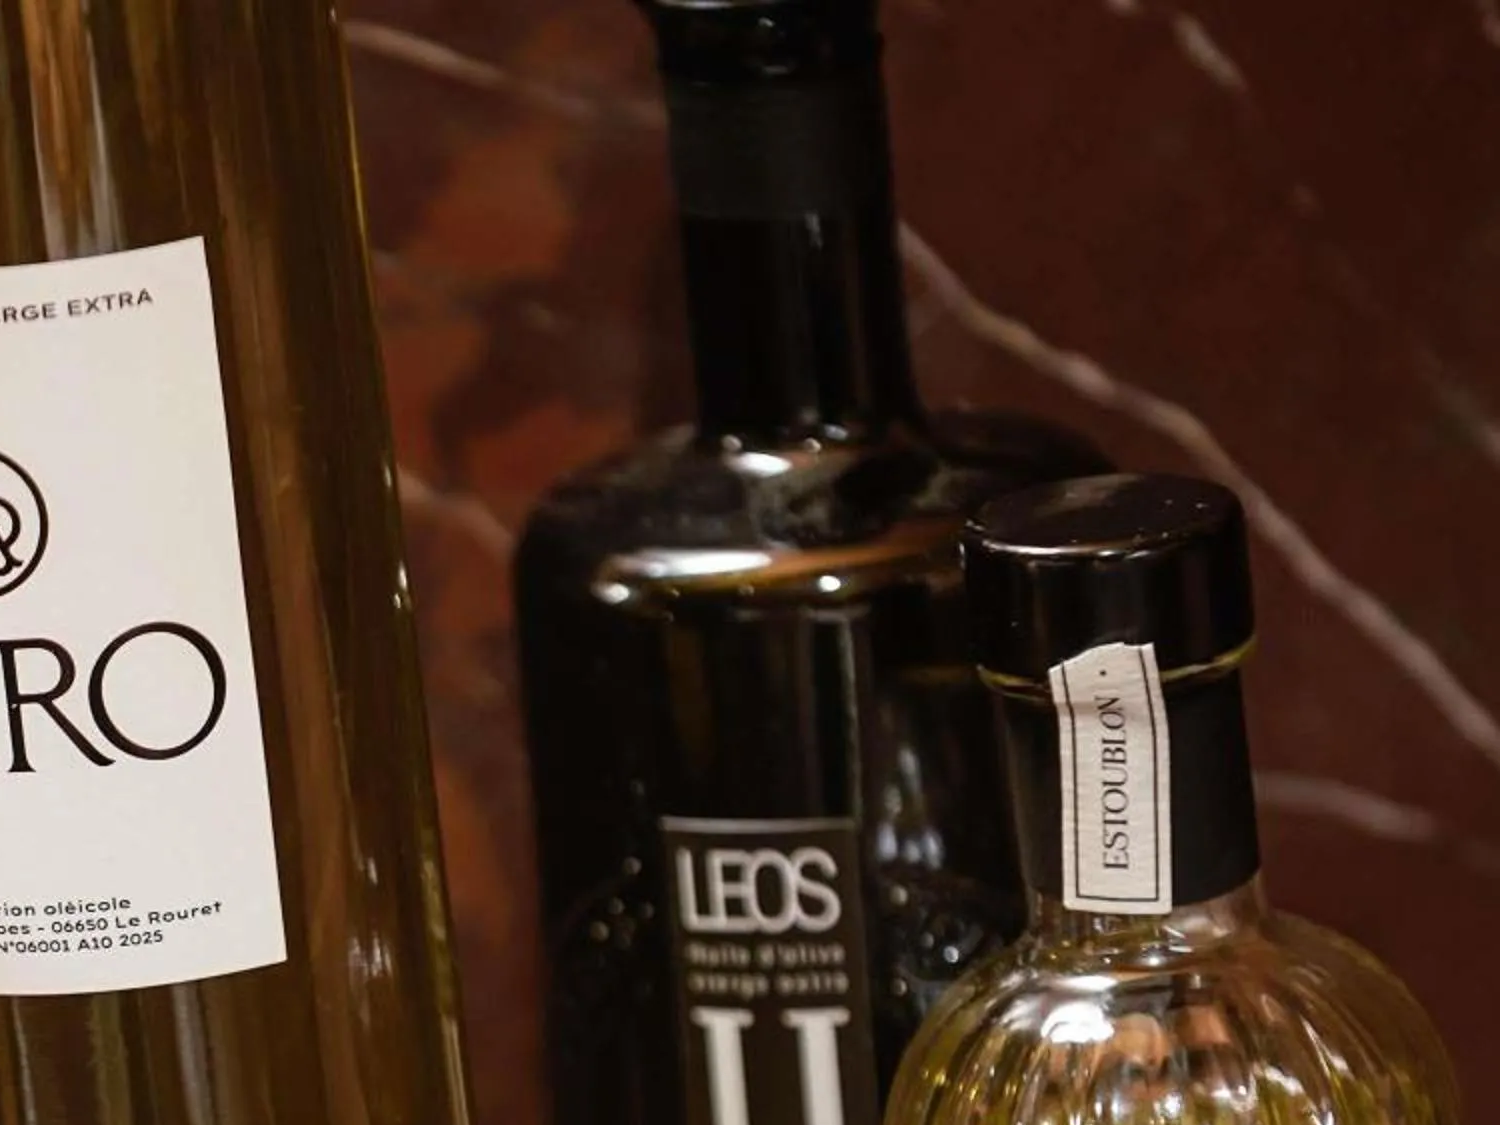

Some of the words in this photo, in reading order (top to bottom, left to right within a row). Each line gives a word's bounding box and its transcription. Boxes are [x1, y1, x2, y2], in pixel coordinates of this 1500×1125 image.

[67, 287, 154, 317] EXTRA
[1094, 696, 1129, 870] ESTOUBLON
[675, 847, 842, 934] LEOS
[44, 898, 131, 915] oléicole
[51, 918, 108, 933] 06650
[115, 916, 140, 929] Le
[149, 901, 221, 924] Rouret
[78, 936, 113, 950] A10
[120, 930, 163, 946] 2025
